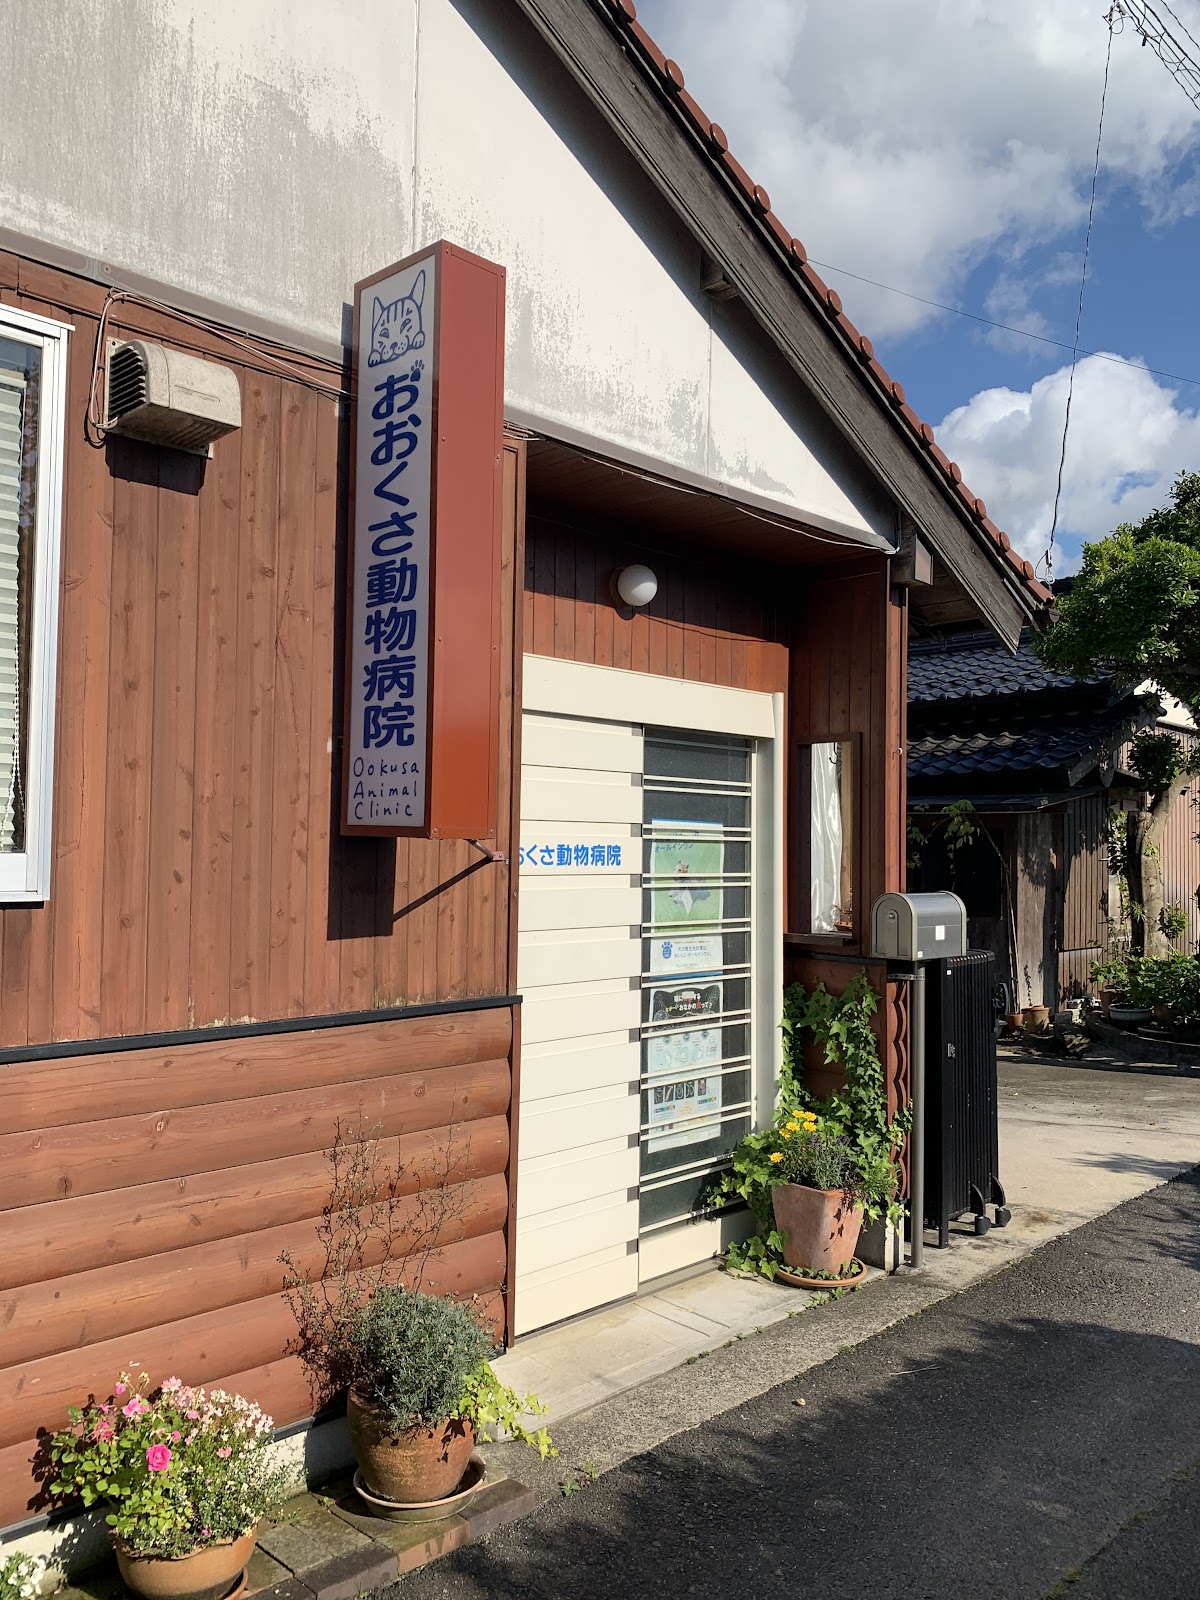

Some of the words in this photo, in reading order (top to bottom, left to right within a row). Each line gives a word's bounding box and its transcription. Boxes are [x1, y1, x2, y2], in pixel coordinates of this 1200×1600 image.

[363, 362, 423, 748] おおくさ動物病院
[353, 756, 420, 778] Ookusa
[353, 780, 417, 799] Animal
[354, 800, 413, 819] Clinic
